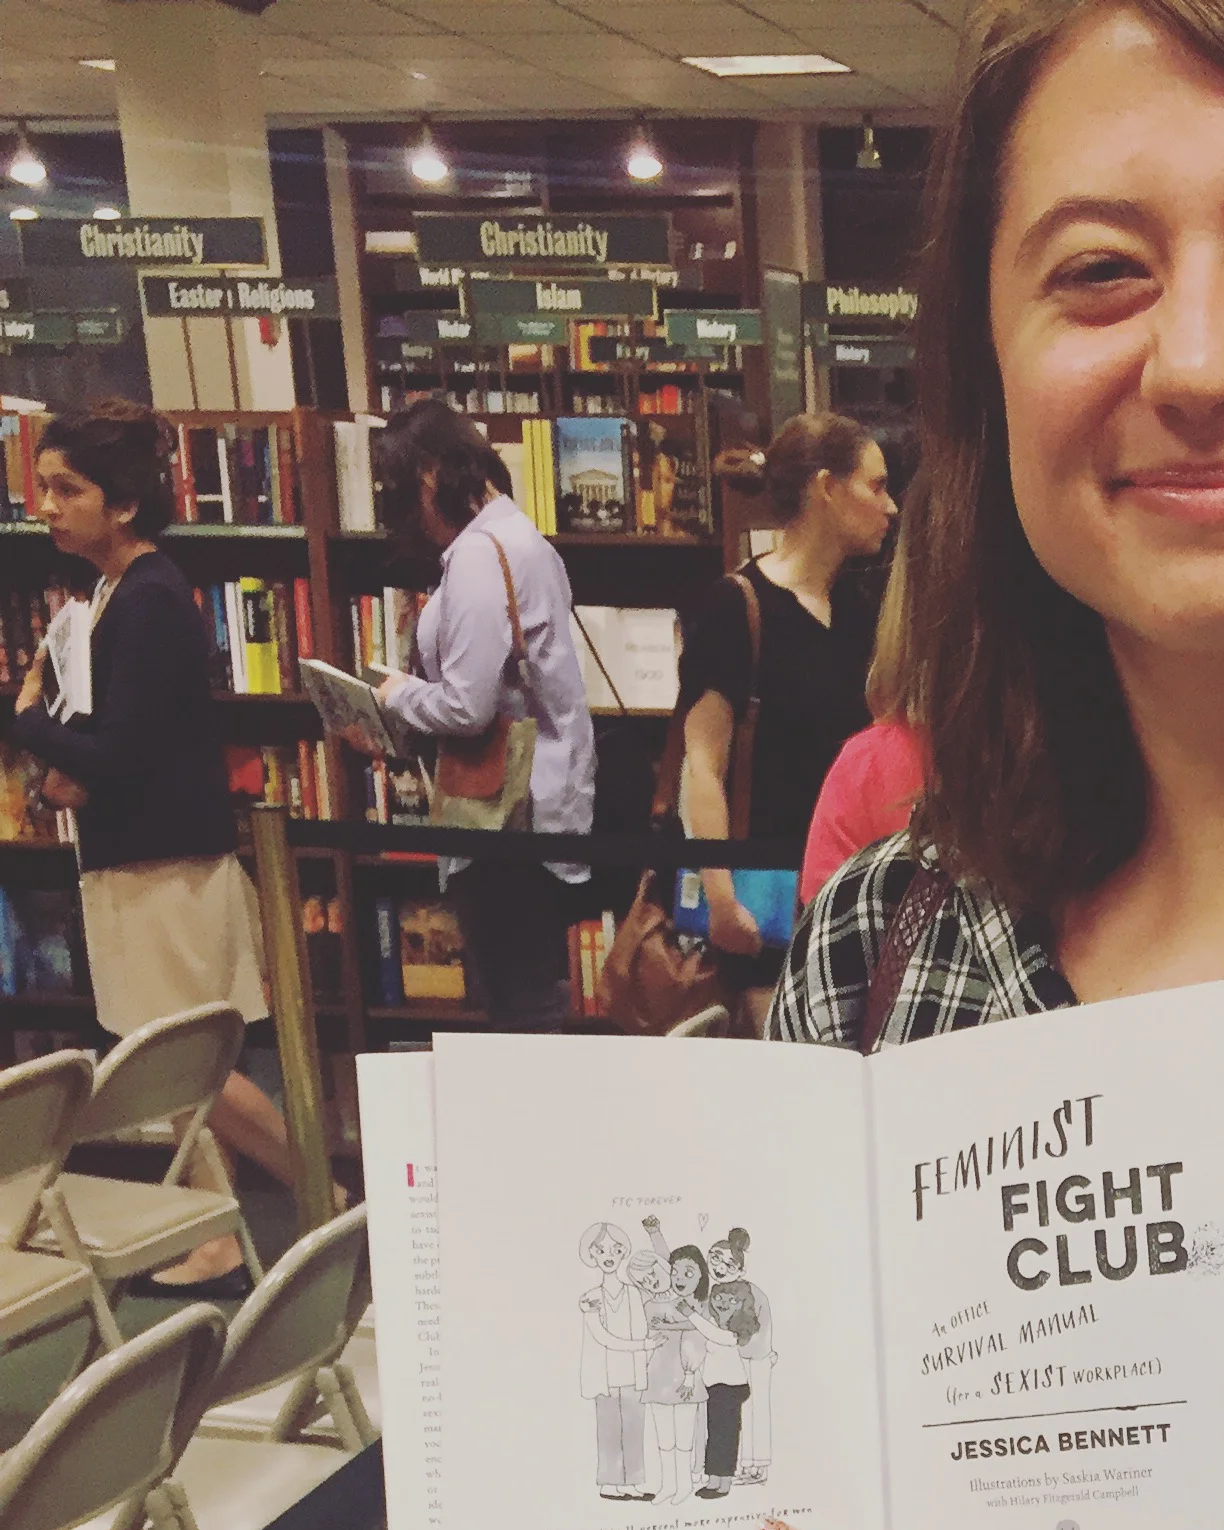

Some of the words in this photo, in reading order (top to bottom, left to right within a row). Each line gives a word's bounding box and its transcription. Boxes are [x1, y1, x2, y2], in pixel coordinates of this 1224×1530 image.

[79, 222, 204, 264] Christianity
[479, 220, 609, 263] Christianity
[237, 281, 315, 314] Religions
[535, 282, 583, 311] Islam
[826, 286, 919, 321] Philosophy
[912, 1094, 1104, 1222] FEMINIST
[1001, 1161, 1184, 1232] FIGHT
[1006, 1220, 1189, 1291] CLUB
[930, 1322, 947, 1338] An
[949, 1300, 992, 1330] OFFICE
[921, 1333, 1009, 1376] SURVIVAL
[1019, 1304, 1100, 1345] MANUAL
[990, 1364, 1068, 1396] SEXIST
[1073, 1357, 1162, 1385] WORKPLACE)
[950, 1434, 1051, 1462] JESSICA
[1058, 1423, 1172, 1451] BENNETT
[969, 1475, 1042, 1492] Illustrations
[1044, 1472, 1060, 1489] by
[1062, 1469, 1100, 1485] Saskia
[986, 1496, 1008, 1508] with
[1009, 1495, 1041, 1507] Hilary
[1043, 1489, 1090, 1505] Fitzgerald
[1092, 1486, 1139, 1501] Campbell
[792, 1507, 813, 1515] men
